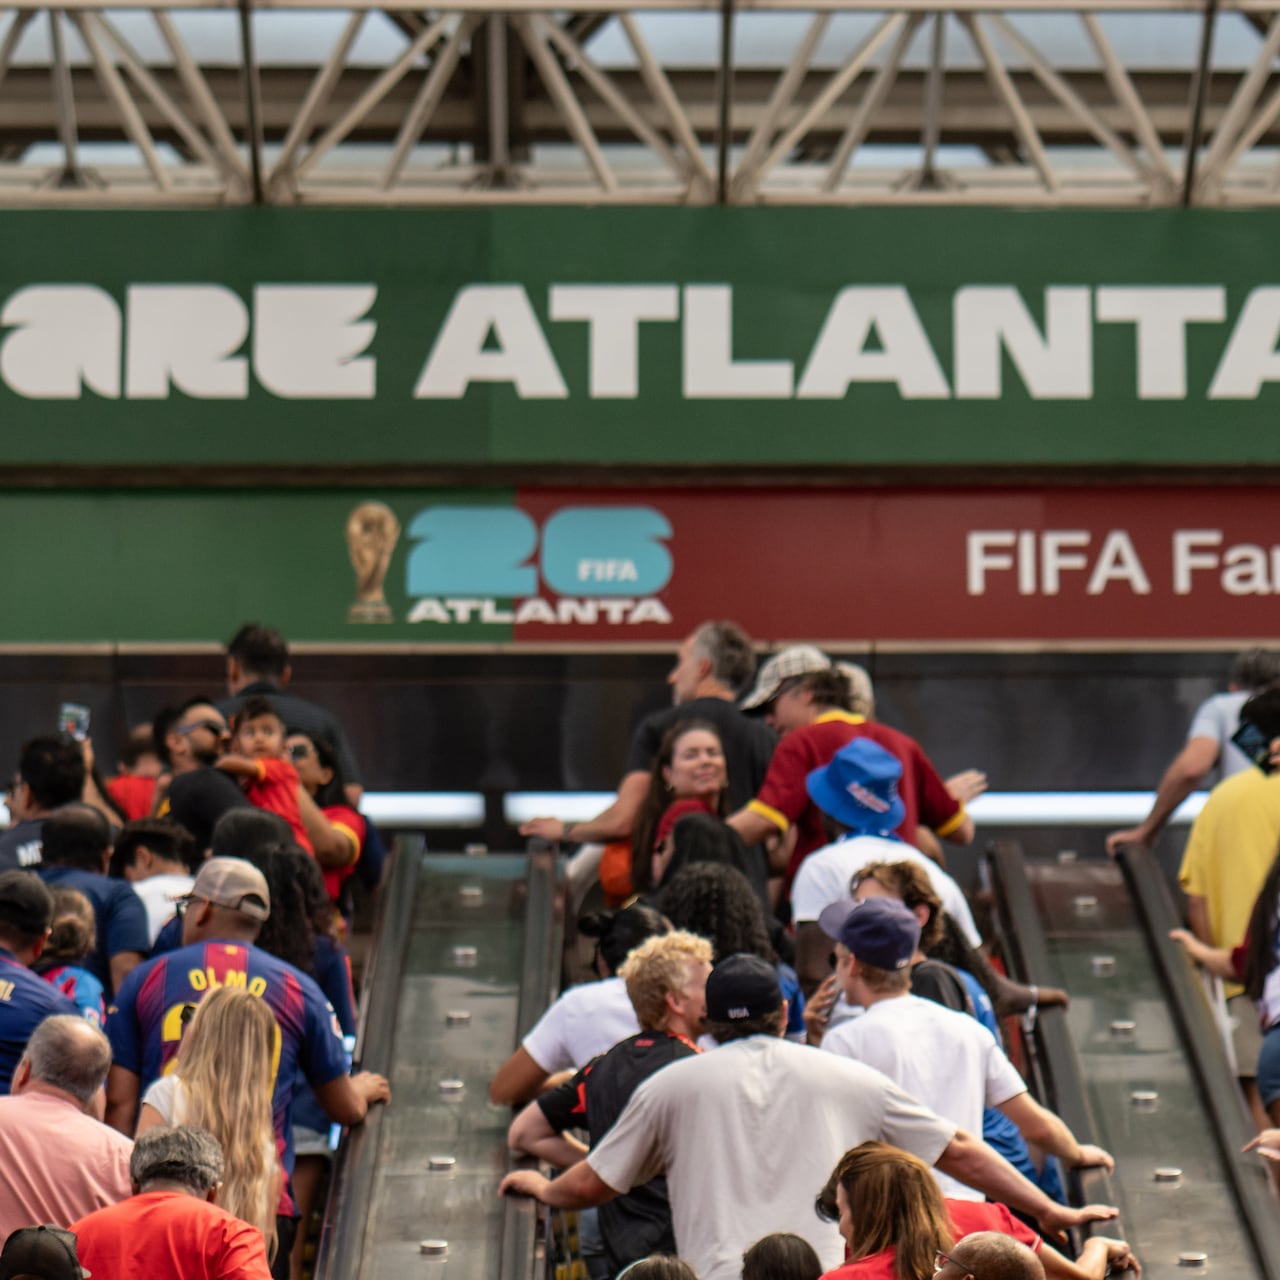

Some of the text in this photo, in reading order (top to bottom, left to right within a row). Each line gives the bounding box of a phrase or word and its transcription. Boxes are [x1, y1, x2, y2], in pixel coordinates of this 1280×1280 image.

[406, 506, 673, 598] 26
[967, 530, 1151, 596] FIFA
[578, 560, 639, 581] FIFA
[407, 598, 672, 624] ATLANTA
[188, 967, 267, 997] OLMO
